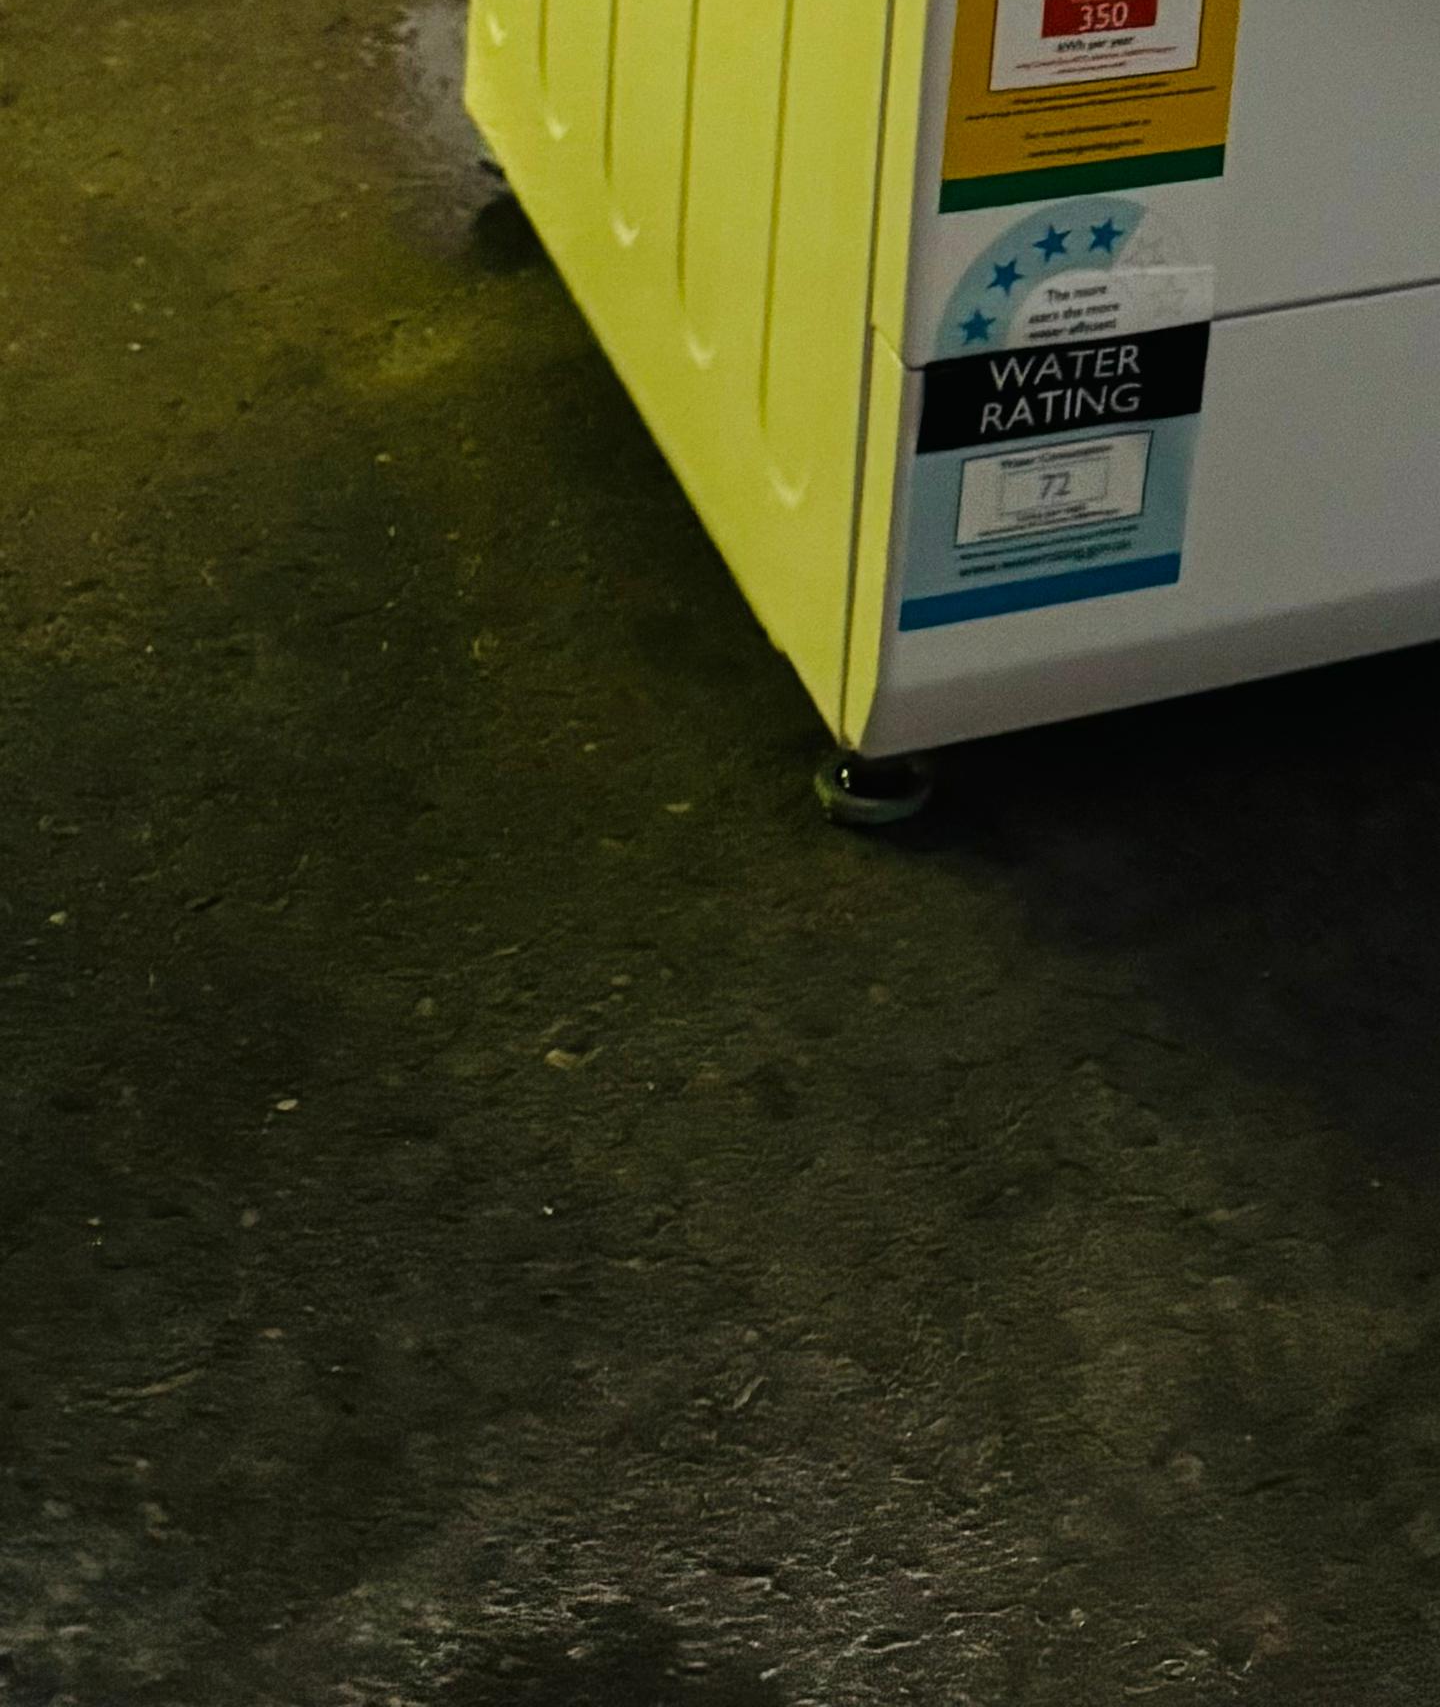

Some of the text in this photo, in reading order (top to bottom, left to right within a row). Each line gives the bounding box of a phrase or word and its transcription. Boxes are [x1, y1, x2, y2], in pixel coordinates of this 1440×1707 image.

[1078, 1, 1128, 31] 350
[1047, 289, 1070, 304] The
[989, 344, 1140, 392] WATER
[979, 384, 1141, 434] RATING
[1040, 471, 1071, 499] 72
